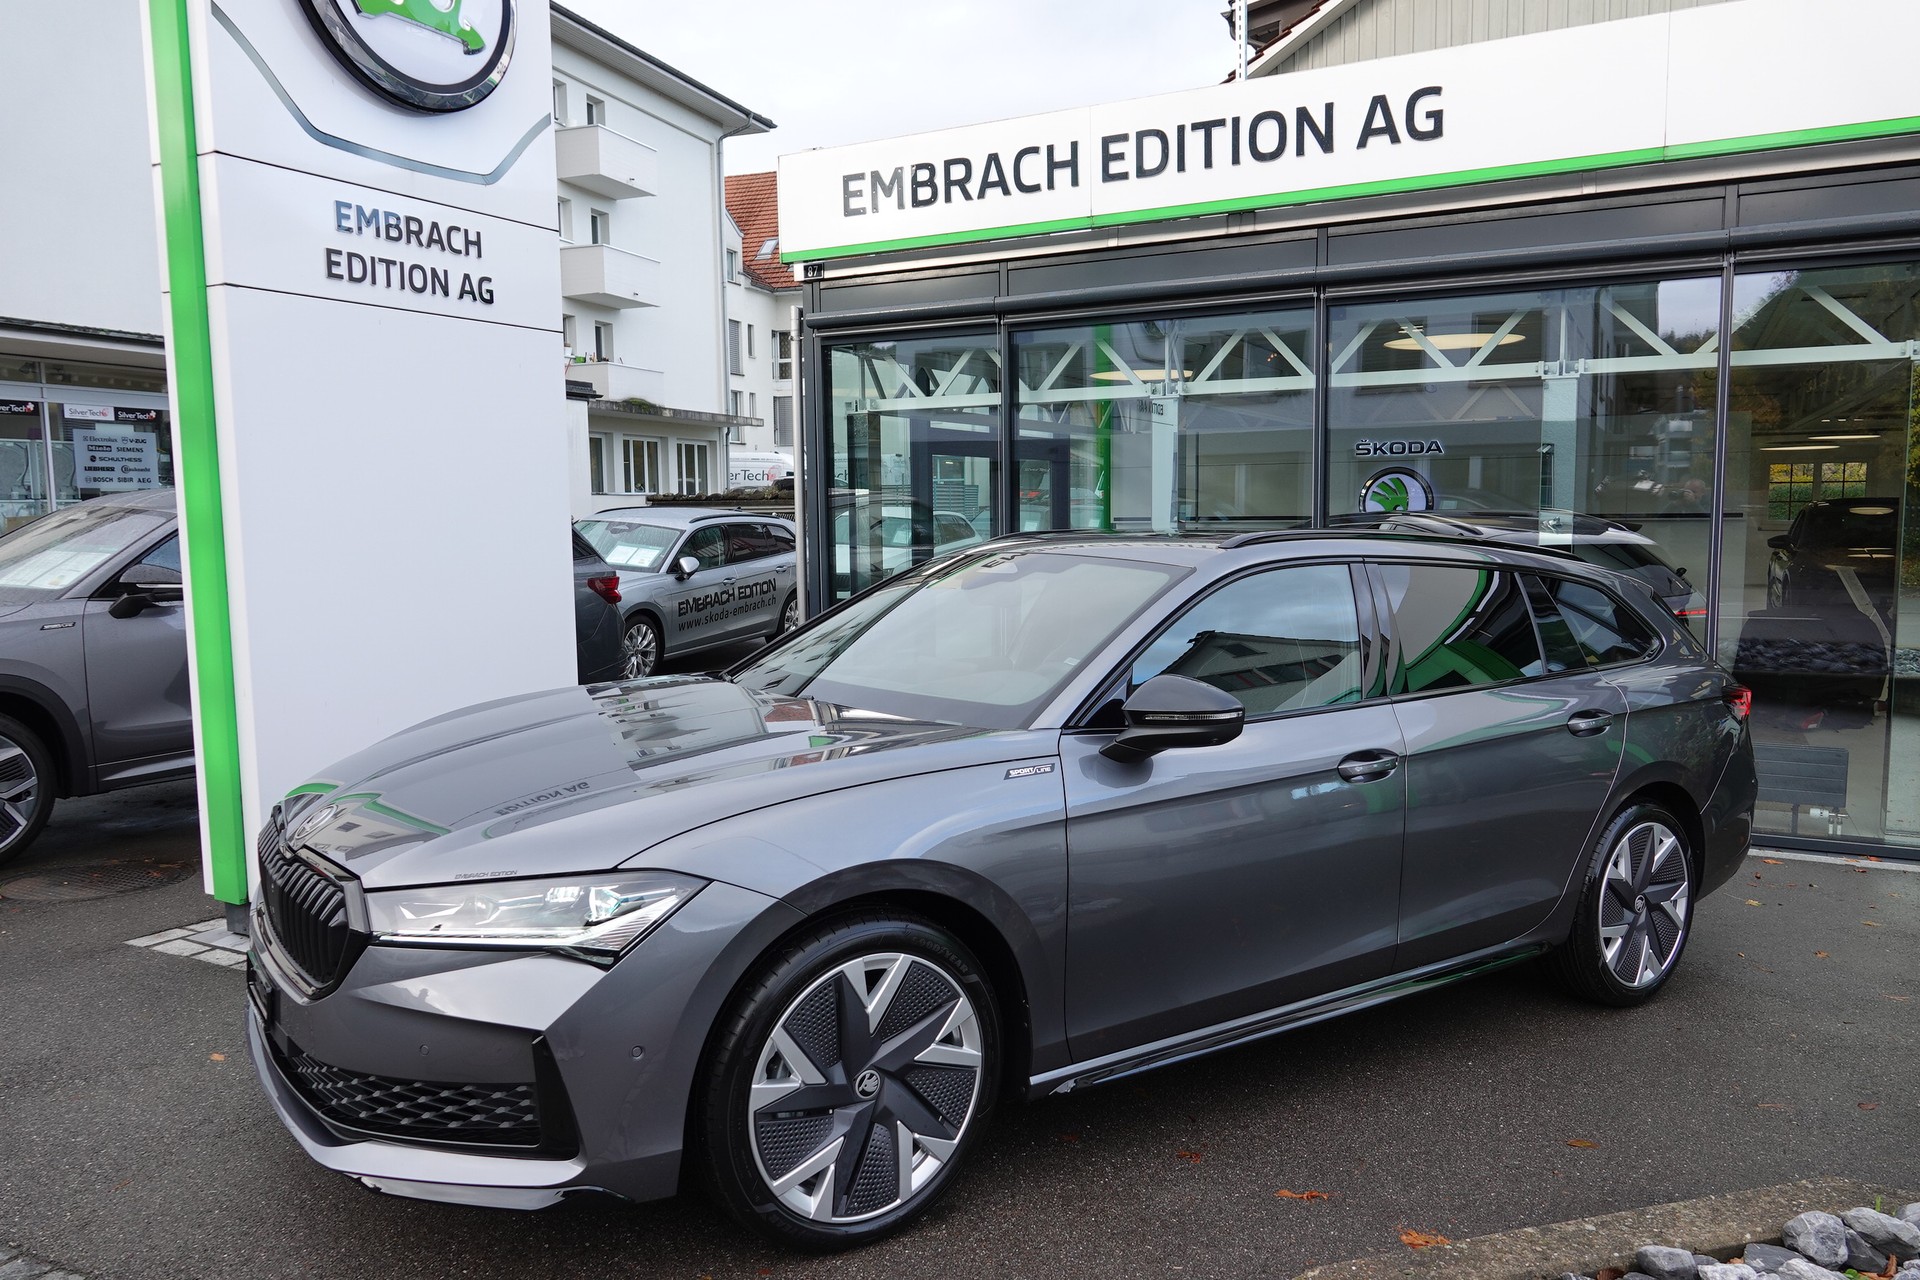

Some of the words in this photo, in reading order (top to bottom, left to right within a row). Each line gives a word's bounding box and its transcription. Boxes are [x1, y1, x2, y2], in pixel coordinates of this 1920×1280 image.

[842, 140, 1080, 218] EMBRACH
[1101, 101, 1335, 183] EDITION
[1356, 85, 1444, 151] AG
[334, 200, 483, 259] EMBRACH
[325, 247, 450, 298] EDITION
[457, 272, 495, 305] AG
[807, 265, 819, 277] 87
[1355, 439, 1444, 456] ŠKODA
[677, 587, 736, 618] EMBRACH
[737, 577, 777, 600] EDITION
[677, 594, 777, 632] www.skoda-embrach.ch
